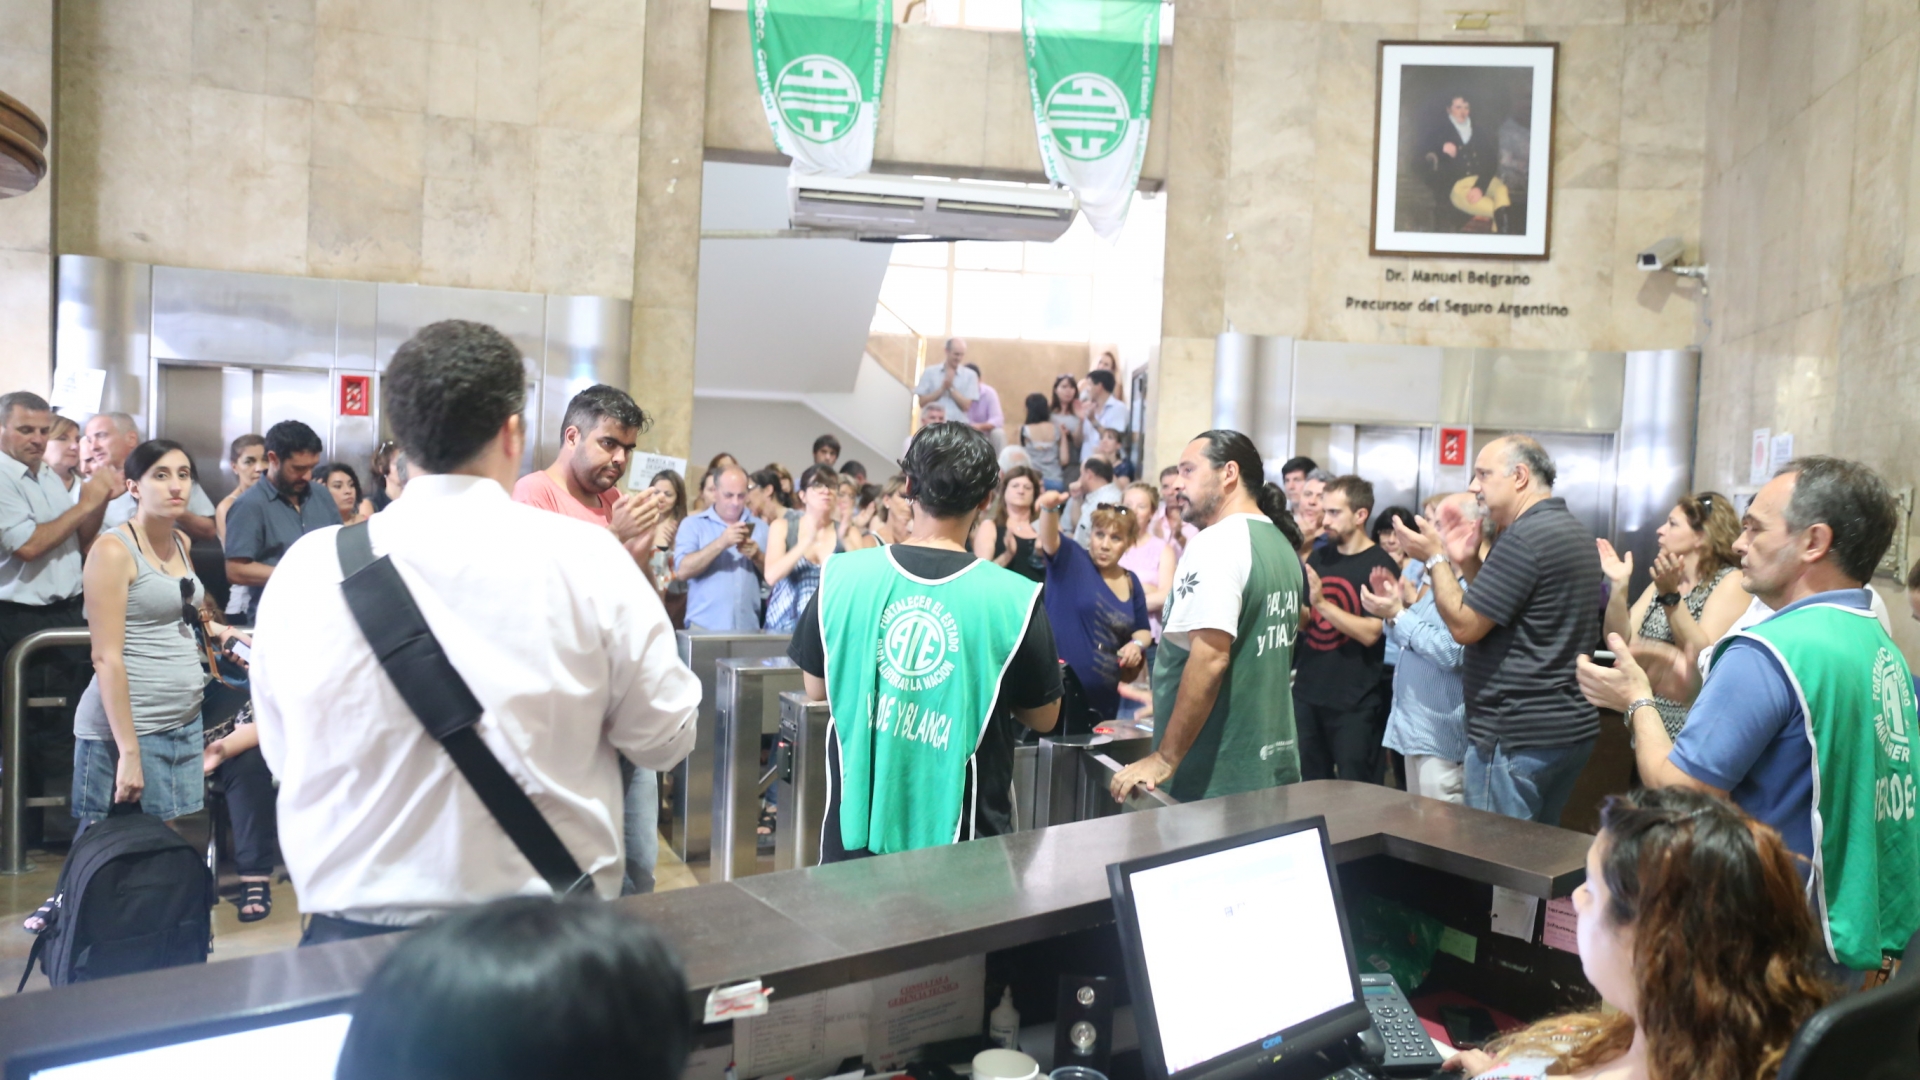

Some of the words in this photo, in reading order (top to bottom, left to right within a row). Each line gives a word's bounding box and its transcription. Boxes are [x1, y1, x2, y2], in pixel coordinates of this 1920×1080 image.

[872, 59, 883, 94] Estado
[1385, 268, 1405, 282] Dr.
[1411, 269, 1462, 283] Manuel
[1467, 271, 1531, 287] Belgrano
[1345, 297, 1412, 311] Precursor
[1418, 299, 1440, 313] del
[1445, 299, 1493, 316] Seguro
[1497, 302, 1569, 318] Argentino
[880, 595, 933, 629] FORTALECER
[931, 601, 944, 617] EL
[940, 613, 960, 653] ESTADO
[891, 616, 940, 671] ATE
[877, 661, 910, 691] LIBERAR
[910, 678, 922, 691] LA
[922, 659, 955, 690] NACION
